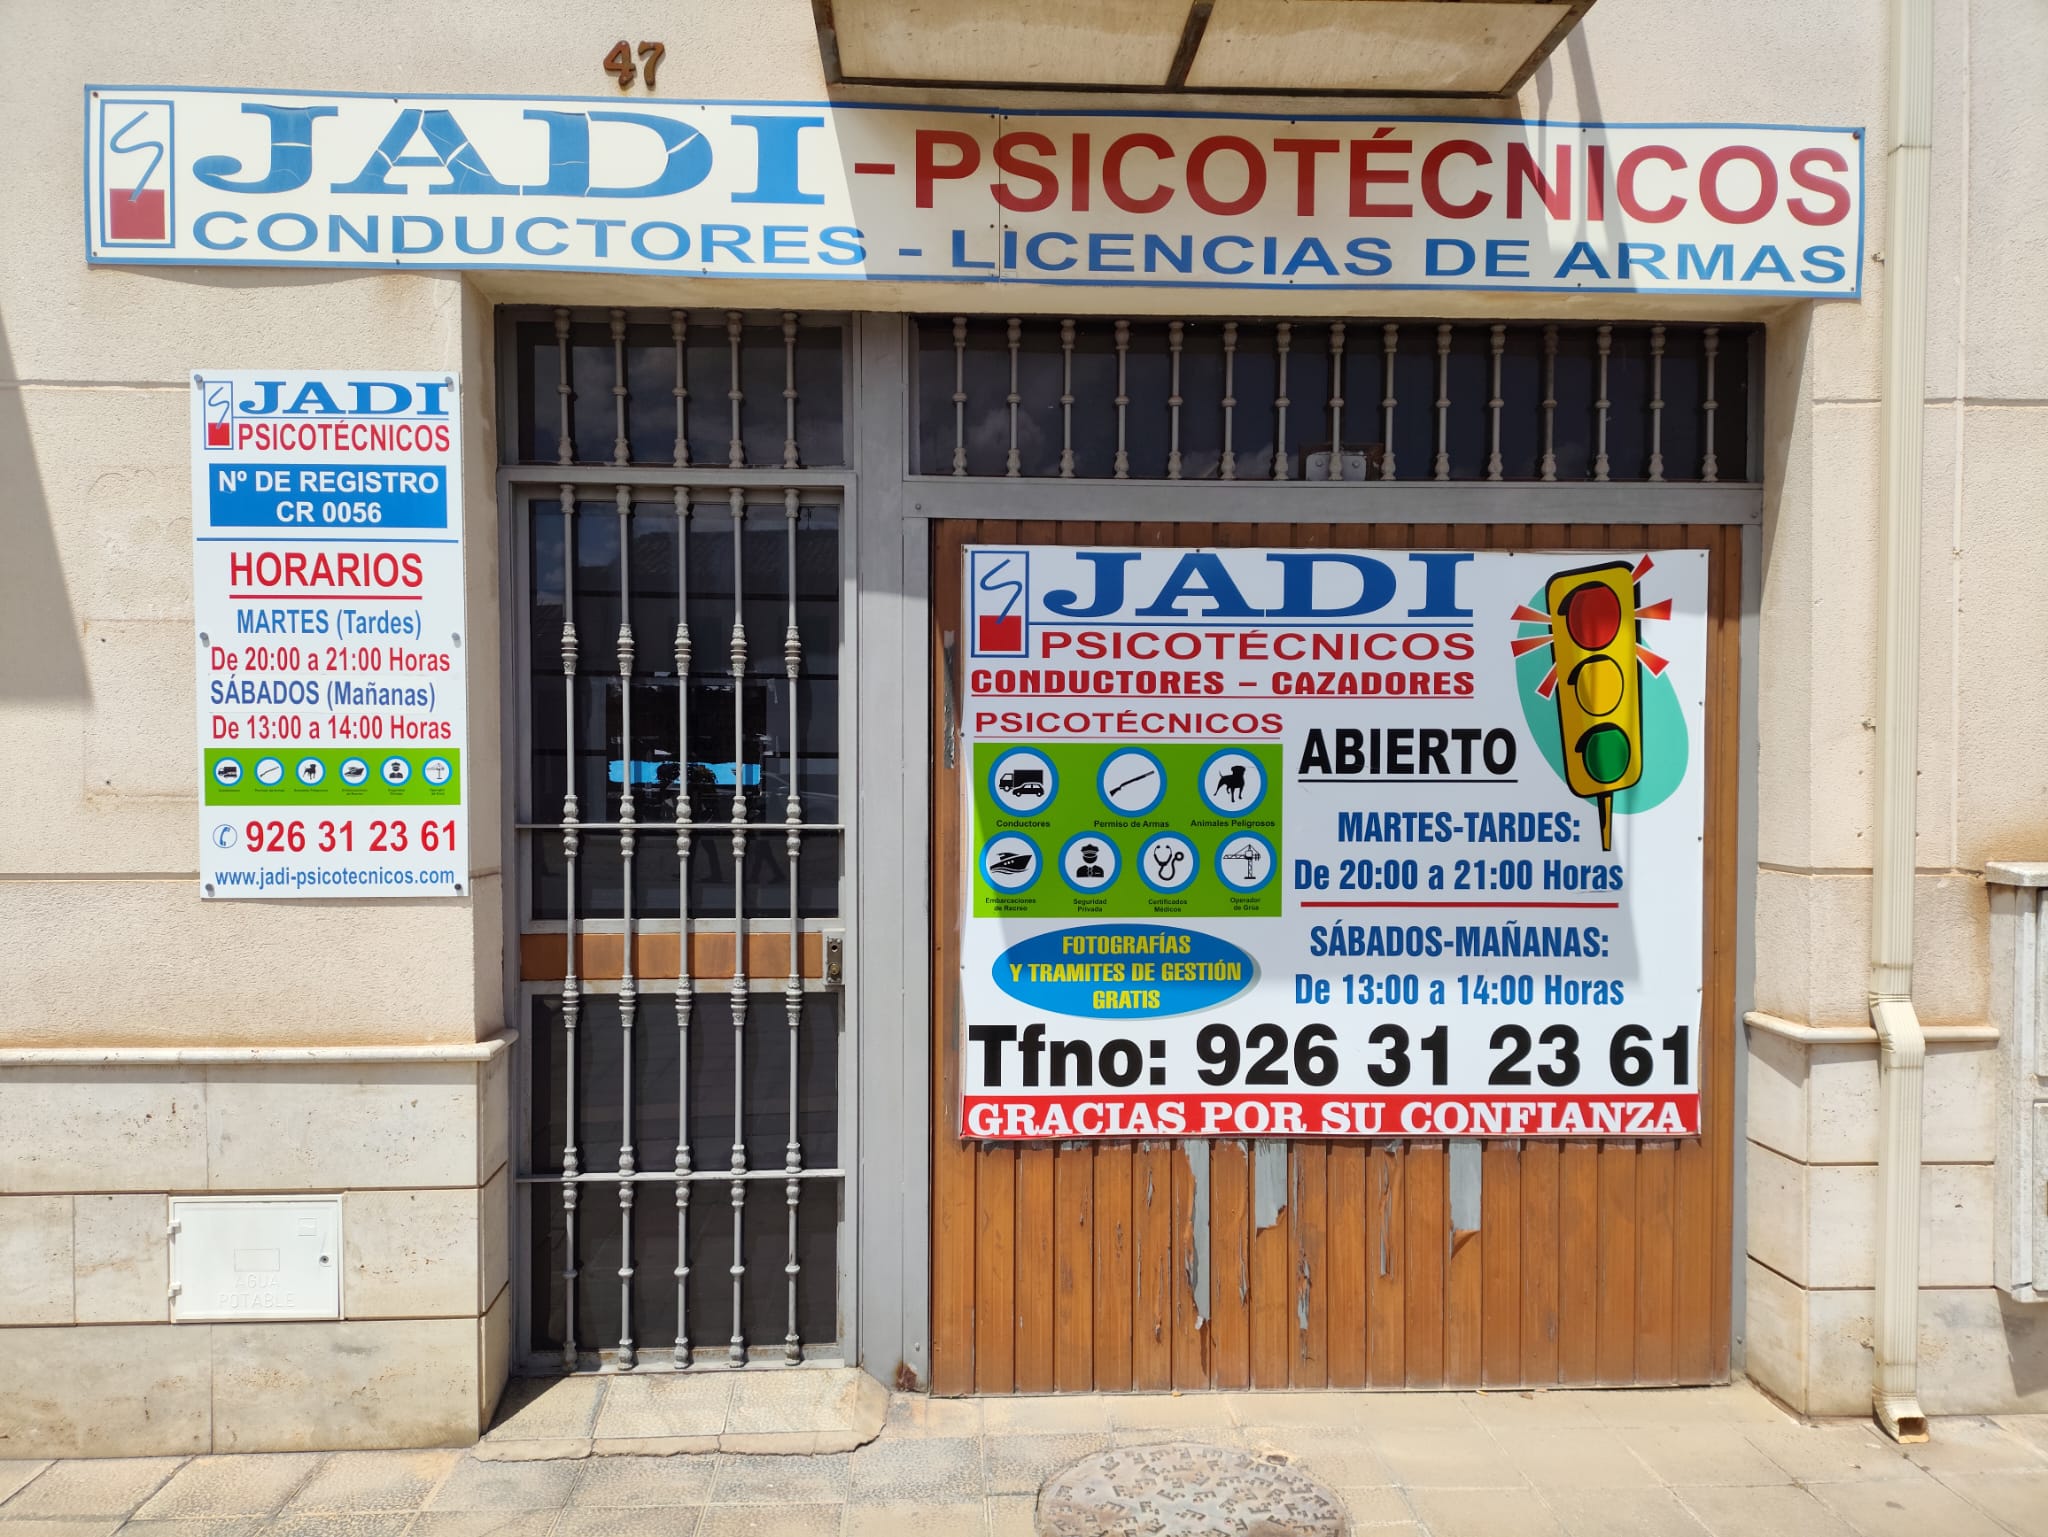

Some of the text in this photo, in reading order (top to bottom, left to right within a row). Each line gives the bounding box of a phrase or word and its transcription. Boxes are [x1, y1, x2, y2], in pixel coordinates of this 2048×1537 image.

[603, 40, 665, 88] 47
[192, 102, 825, 205] JADI
[914, 126, 1852, 227] PSICOTÉCNICOS
[192, 210, 867, 265] CONDUCTORES
[951, 228, 1393, 279] LICENCIAS
[1425, 238, 1529, 278] DE
[1553, 239, 1847, 284] ARMAS
[239, 381, 449, 415] JADI
[238, 420, 450, 452] PSICOTÉCNICOS
[255, 471, 291, 492] DE
[300, 471, 439, 494] REGISTRO
[276, 501, 382, 523] CR 0056
[231, 552, 423, 588] HORARIOS
[1043, 551, 1474, 618] JADI
[237, 609, 422, 640] MARTES (Tardes)
[211, 646, 451, 672] De 20:00 a 21:00 Horas
[1042, 629, 1475, 661] PSICOTÉCNICOS
[210, 674, 435, 712] SÁBADOS (Mañanas)
[971, 669, 1224, 695] CONDUCTORES
[1272, 671, 1474, 696] CAZADORES
[212, 714, 452, 740] De 13:00 a 14:00 Horas
[975, 710, 1283, 734] PSICOTÉCNICOS
[1298, 727, 1517, 776] ABIERTO
[246, 820, 456, 852] 926 31 23 61
[996, 819, 1051, 828] Conductores
[1093, 820, 1170, 828] Permiso de Armas
[1190, 819, 1276, 829] Animales Peligrosos
[1338, 812, 1580, 843] MARTES-TARDES:
[215, 866, 455, 889] www.jadi-psicotecnicos.com
[1294, 859, 1624, 891] De 20:00 a 21:00 Horas
[1073, 898, 1108, 906] Seguridad
[1077, 905, 1103, 913] Privada
[1148, 898, 1188, 906] Certificados
[1062, 932, 1191, 955] FOTOGRAFÍAS
[1310, 920, 1609, 958] SÁBADOS-MAÑANAS:
[1009, 960, 1241, 982] Y TRAMITES DE GESTIÓN
[1092, 990, 1161, 1010] GRATIS
[1295, 974, 1624, 1005] De 13:00 a 14:00 Horas
[968, 1023, 1689, 1088] Tfno: 926 31 23 61
[967, 1101, 1686, 1136] GRACIAS POR SU CONFIANZA
[234, 1274, 281, 1289] AGUA
[219, 1293, 297, 1309] POTABLE
